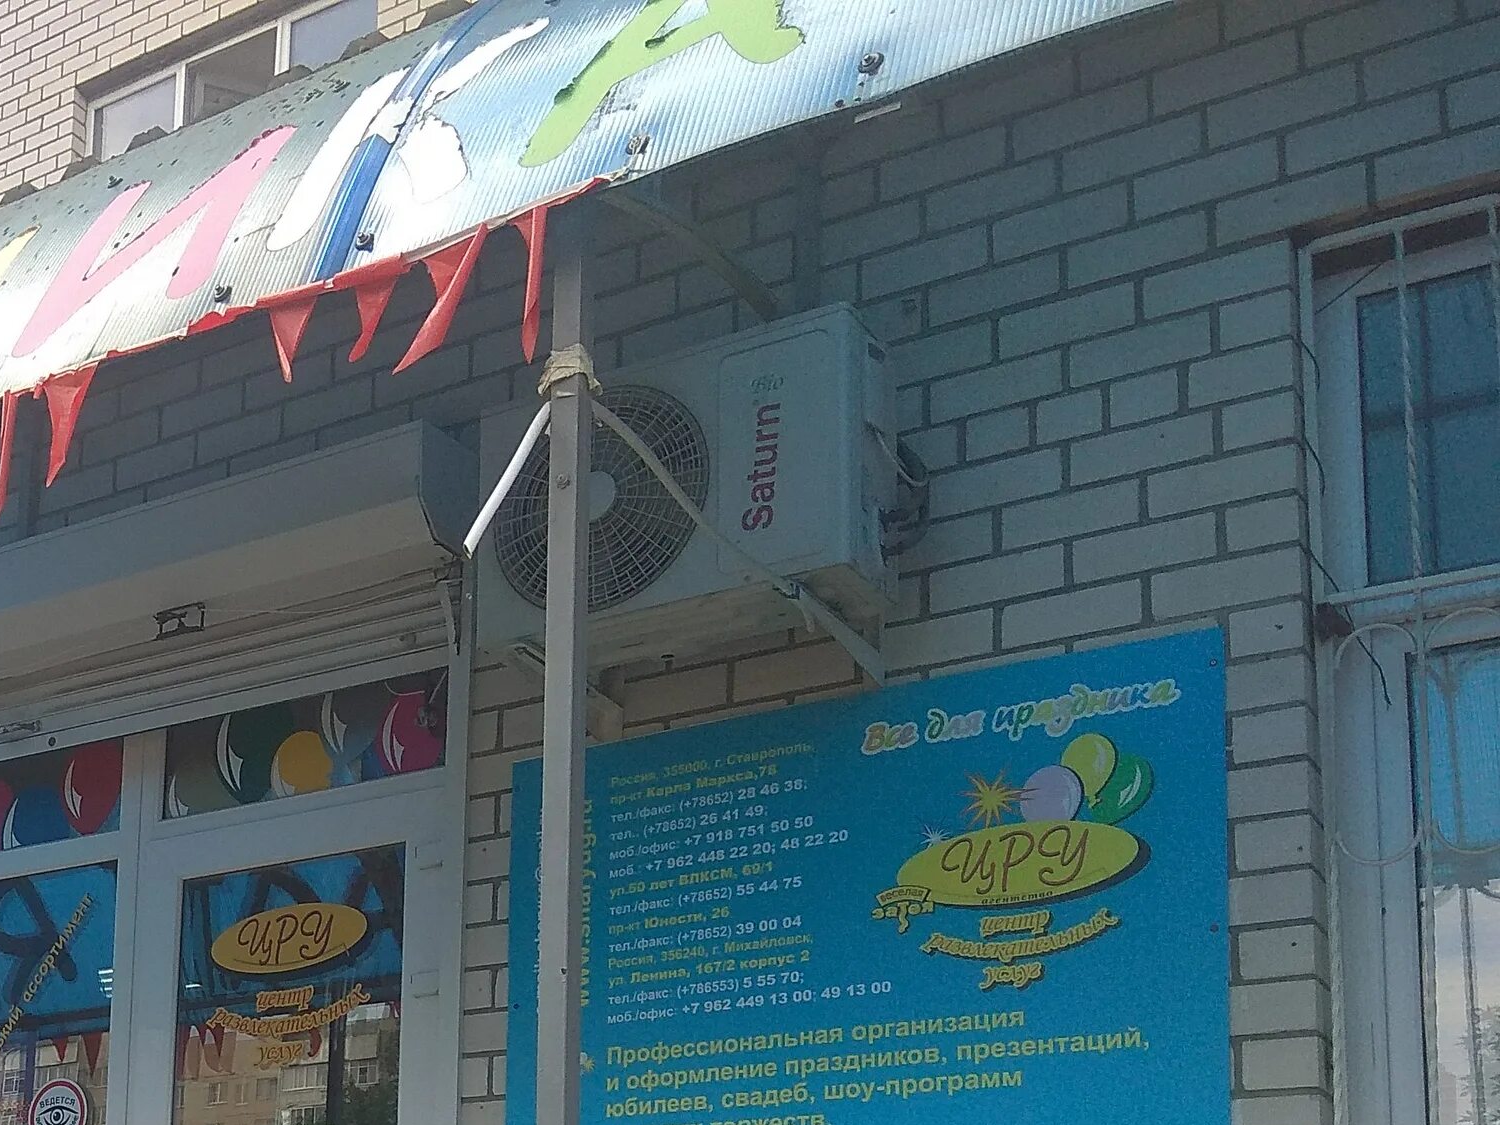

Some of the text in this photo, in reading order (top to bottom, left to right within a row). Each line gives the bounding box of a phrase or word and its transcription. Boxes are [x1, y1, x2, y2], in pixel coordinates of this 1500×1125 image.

[741, 403, 781, 531] Saturn
[861, 679, 1181, 755] Все для праздника
[647, 782, 692, 798] Карла
[679, 791, 734, 812] (+78652)
[760, 782, 779, 797] 46
[643, 809, 740, 839] (+78652) 26 41
[684, 815, 814, 847] +7 918 751 50 50
[645, 859, 663, 873] +7
[667, 853, 694, 868] 962
[729, 845, 749, 859] 22
[805, 833, 825, 847] 22
[828, 829, 849, 843] 20
[941, 825, 1089, 895] ЦРУ
[678, 886, 733, 908] (+78652)
[736, 882, 755, 896] 55
[759, 879, 779, 893] 44
[783, 875, 802, 889] 75
[677, 924, 733, 946] (+78652)
[736, 921, 755, 936] 39
[759, 918, 779, 933] 00
[782, 914, 803, 929] 04
[711, 907, 731, 920] 26
[980, 911, 1051, 937] центр
[23, 892, 94, 1003] ассортимент
[237, 910, 334, 966] ЦРУ
[920, 907, 1121, 963] развлекательных
[630, 966, 692, 984] Ленина,
[740, 952, 796, 972] корпус
[800, 950, 811, 963] 2
[743, 974, 753, 989] 5
[757, 971, 777, 986] 55
[980, 961, 1045, 990] услуг
[205, 983, 371, 1039] развлекательных
[256, 985, 314, 1013] центр
[682, 979, 892, 1015] +7 962 449 13 49 13 00
[606, 1010, 1025, 1068] Профессиональная организация
[253, 1042, 304, 1071] услуг
[606, 1026, 1150, 1092] и оформление праздников, презентаций,
[40, 1097, 76, 1109] ВЕДЕТСЯ
[606, 1069, 1023, 1118] юбилеев, свадеб, шоу-программ
